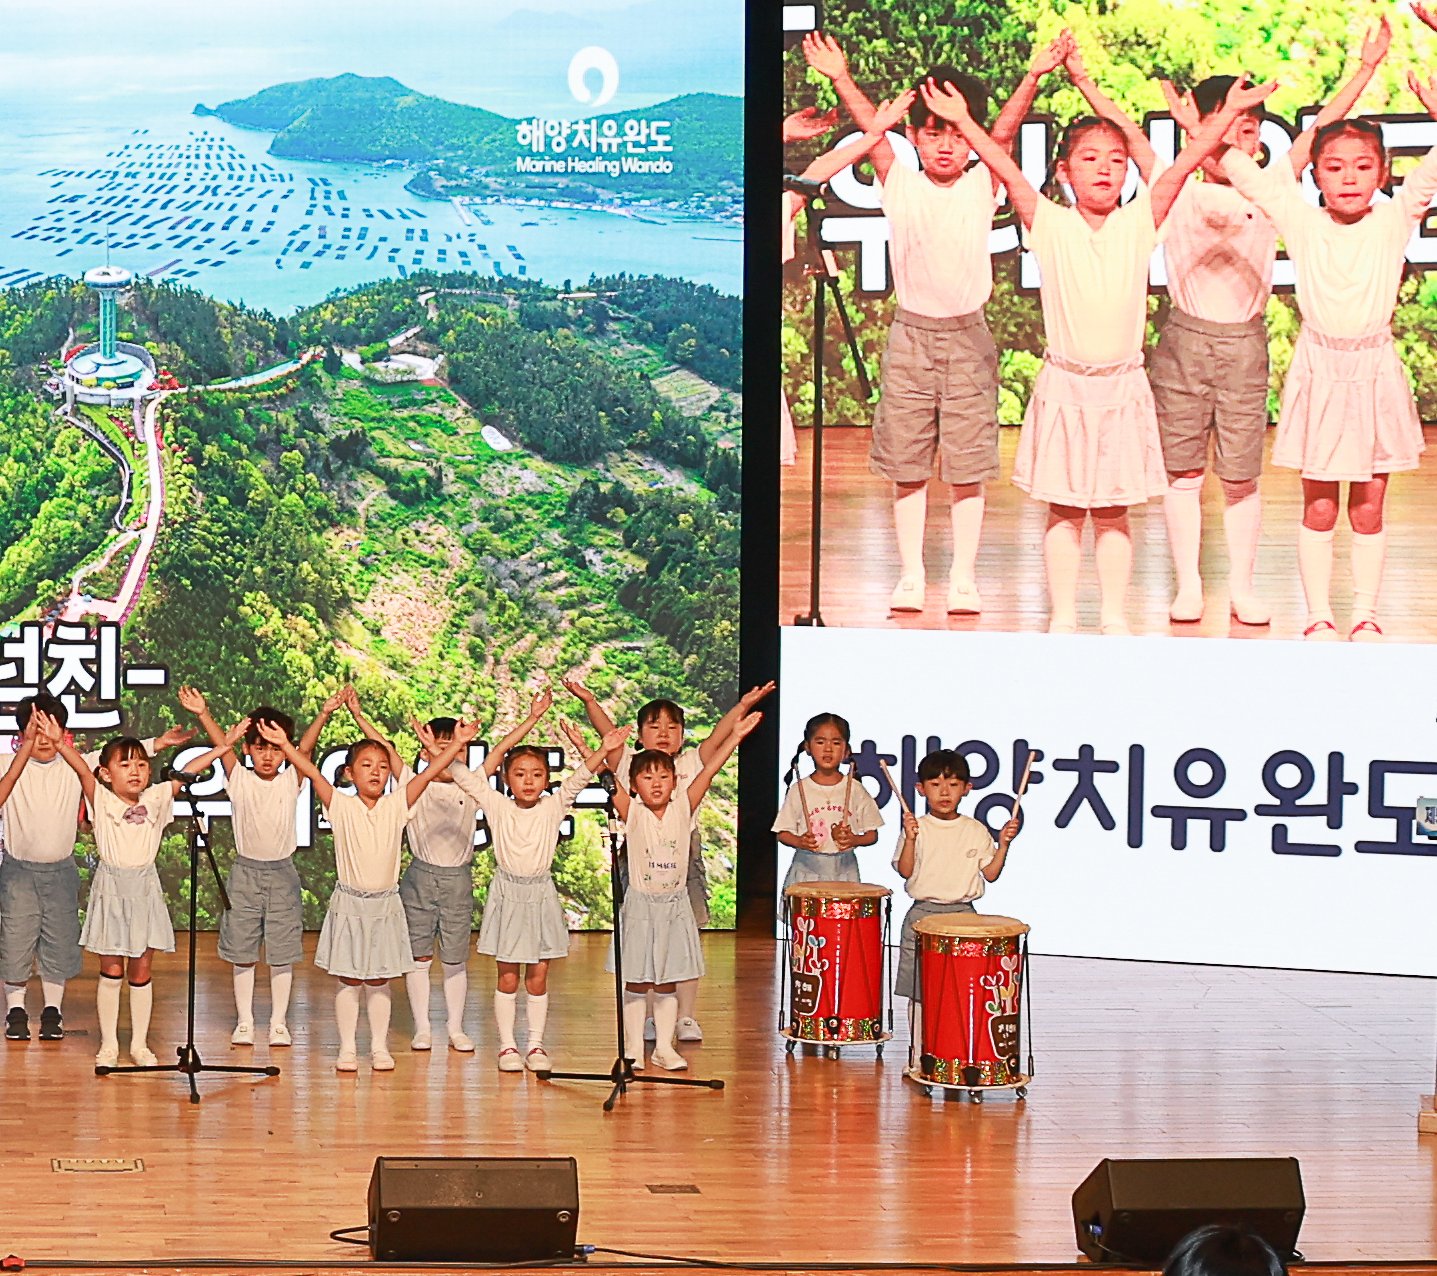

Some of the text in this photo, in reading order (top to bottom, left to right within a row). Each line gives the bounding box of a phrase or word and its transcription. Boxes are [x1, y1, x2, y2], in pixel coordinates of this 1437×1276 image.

[515, 119, 674, 154] 해양치유완도
[516, 156, 674, 178] Marine Healing Wando
